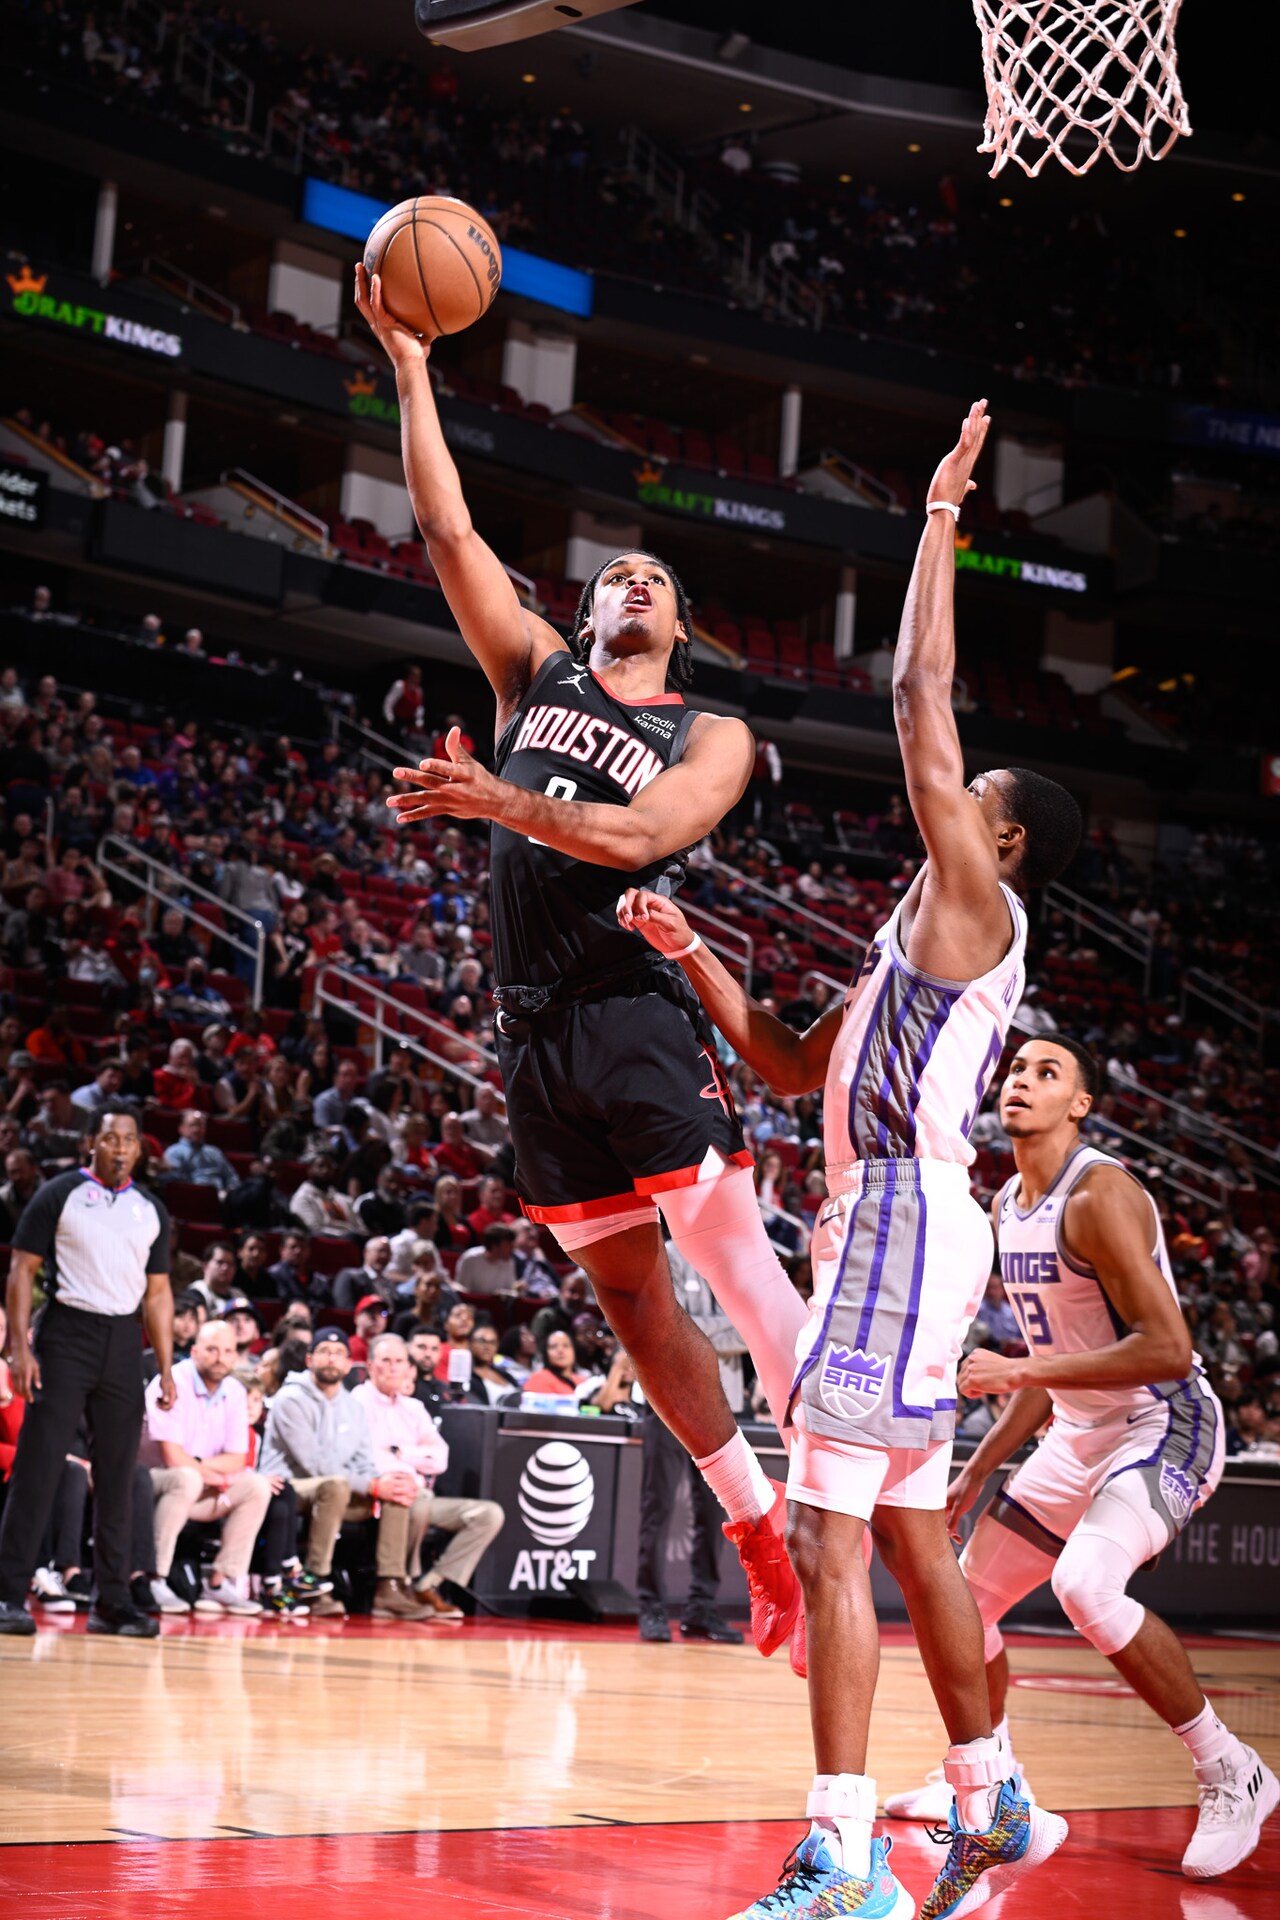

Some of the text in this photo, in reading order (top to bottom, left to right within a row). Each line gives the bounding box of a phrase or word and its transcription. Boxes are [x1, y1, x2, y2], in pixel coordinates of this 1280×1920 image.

[13, 290, 182, 357] DRAFTKINGS
[634, 715, 672, 740] karma
[641, 712, 676, 732] credit
[511, 705, 665, 799] HOUSTON
[1000, 1252, 1062, 1284] INGS
[823, 1368, 882, 1396] SAC
[509, 1550, 596, 1591] AT&T
